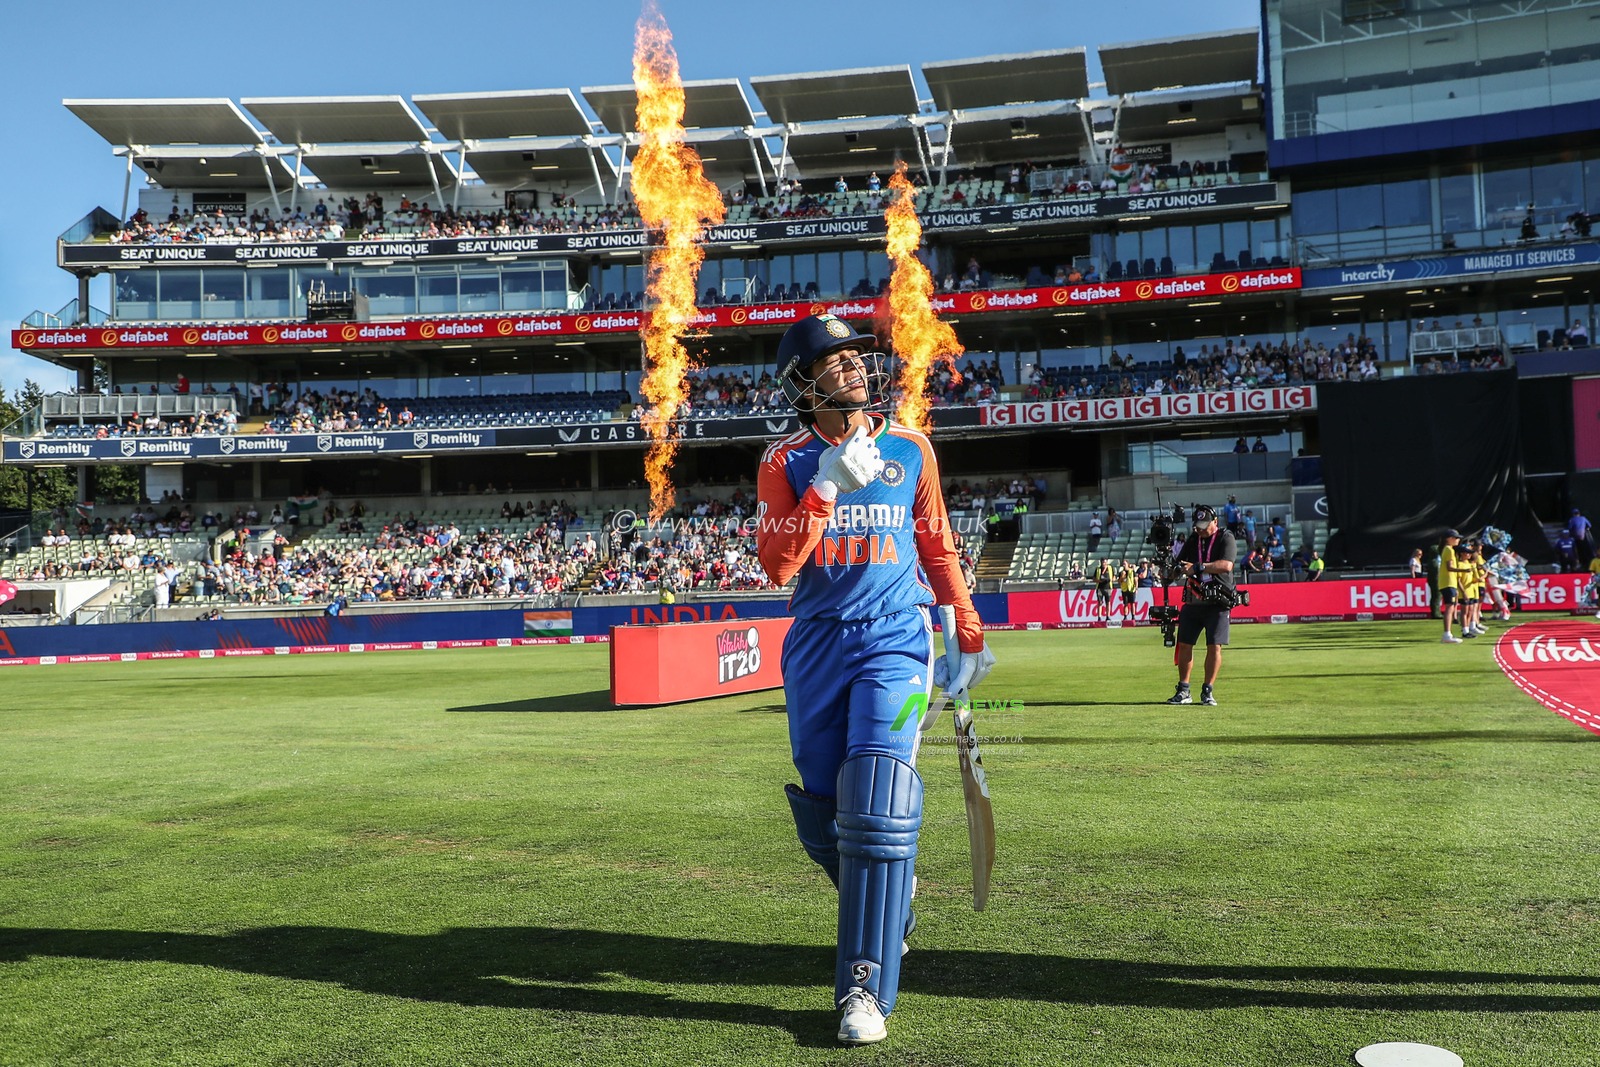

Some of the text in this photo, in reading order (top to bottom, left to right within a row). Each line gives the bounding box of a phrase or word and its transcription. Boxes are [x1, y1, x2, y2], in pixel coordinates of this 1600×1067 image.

[1129, 193, 1216, 210] SEAT UNIQUE
[933, 212, 981, 226] UNIQUE
[1012, 203, 1097, 221] SEAT UNIQUE
[709, 228, 757, 240] UNIQUE
[786, 221, 868, 236] SEAT UNIQUE
[457, 239, 538, 253] SEAT UNIQUE
[567, 233, 648, 248] SEAT UNIQUE
[120, 248, 206, 260] SEAT UNIQUE
[235, 246, 318, 259] SEAT UNIQUE
[347, 243, 429, 256] SEAT UNIQUE
[1464, 248, 1576, 270] MANAGED IT SERVICES
[1154, 279, 1206, 295] dafabet
[1241, 272, 1293, 288] dafabet
[987, 292, 1038, 307] dafabet
[1070, 286, 1120, 301] dafabet
[748, 308, 796, 321] dafabet
[437, 323, 484, 336] dafabet
[514, 320, 561, 333] dafabet
[592, 316, 639, 329] dafabet
[38, 332, 87, 344] dafabet
[120, 331, 169, 343] dafabet
[201, 330, 249, 342] dafabet
[280, 328, 327, 340] dafabet
[359, 325, 406, 338] dafabet
[1168, 395, 1192, 415] IG
[1205, 392, 1230, 413] IG
[1242, 390, 1266, 410] IG
[1280, 387, 1305, 410] IG
[1022, 404, 1046, 423] IG
[1058, 402, 1082, 422] IG
[1094, 400, 1118, 420] IG
[1131, 397, 1155, 417] IG
[987, 405, 1010, 426] IG
[238, 438, 288, 452] Remitly
[335, 436, 385, 449] Remitly
[431, 432, 481, 446] Remitly
[38, 443, 90, 457] Remitly
[139, 441, 191, 455] Remitly
[815, 534, 899, 567] INDIA
[1521, 579, 1566, 604] ife
[631, 604, 738, 624] INDIA
[718, 631, 749, 656] Vitality
[1513, 634, 1600, 663] Vital
